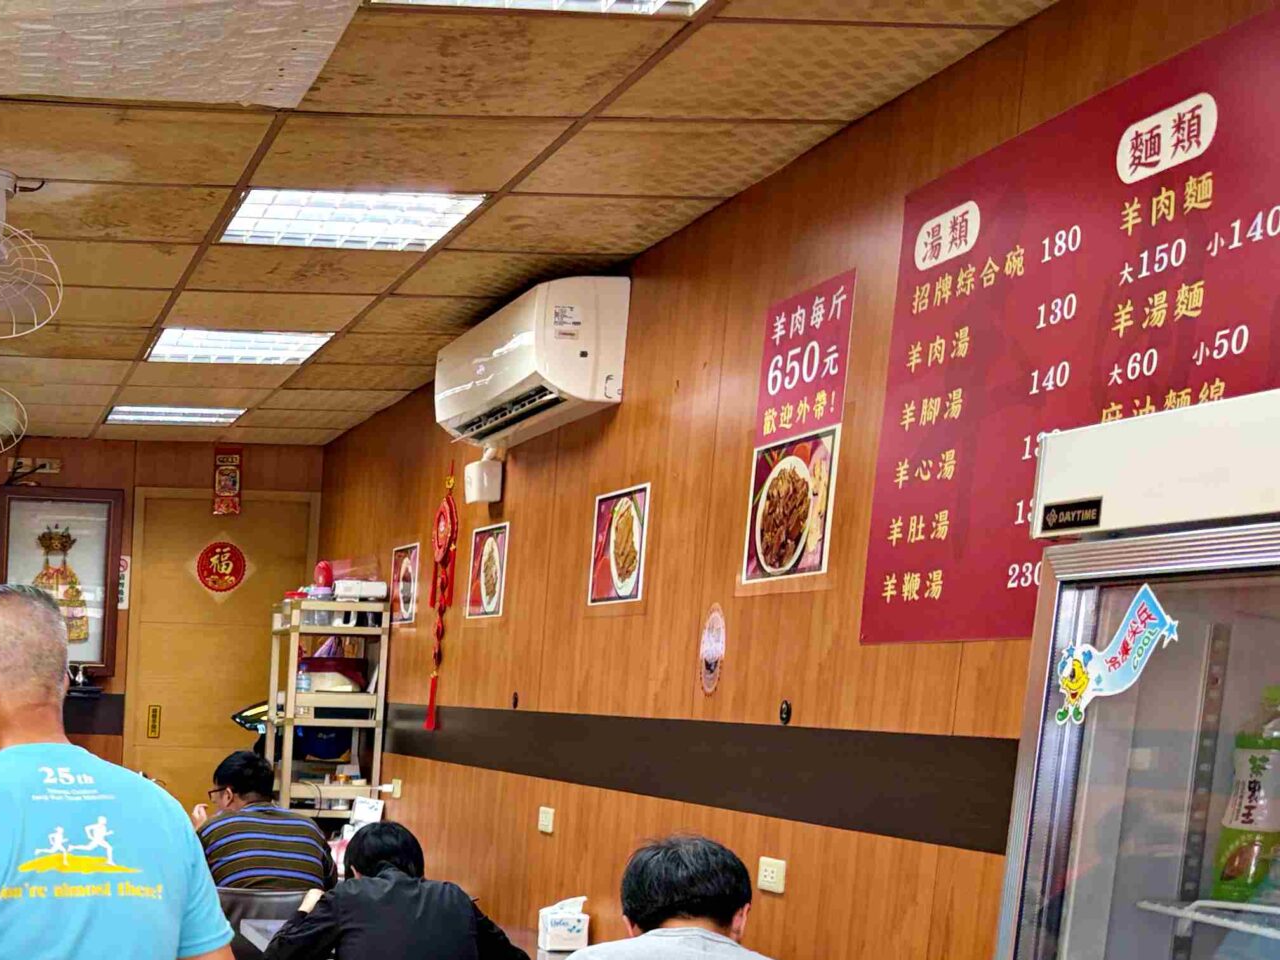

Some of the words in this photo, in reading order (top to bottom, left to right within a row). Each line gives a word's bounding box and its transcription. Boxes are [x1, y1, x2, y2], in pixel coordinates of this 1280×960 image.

[1128, 104, 1203, 176] 麵類
[1120, 172, 1213, 237] 羊肉麵
[922, 209, 970, 263] 湯類
[1118, 238, 1187, 287] 大150
[911, 244, 1026, 315] 招牌綜合碗
[1040, 224, 1082, 264] 180
[771, 285, 847, 347] 羊肉每斤
[906, 326, 971, 374] 羊肉湯
[1035, 293, 1078, 330] 130
[1111, 280, 1205, 339] 羊湯麵
[767, 340, 840, 396] 650元
[1107, 348, 1158, 387] 大60
[1191, 324, 1249, 366] 小50
[899, 387, 965, 432] 羊腳湯
[1028, 361, 1071, 395] 140
[893, 448, 957, 490] 羊心湯
[886, 510, 951, 548] 羊肚湯
[1058, 508, 1097, 523] DAYTIME
[209, 547, 233, 575] 福
[882, 569, 944, 605] 羊鞭湯
[1132, 627, 1159, 671] COOL
